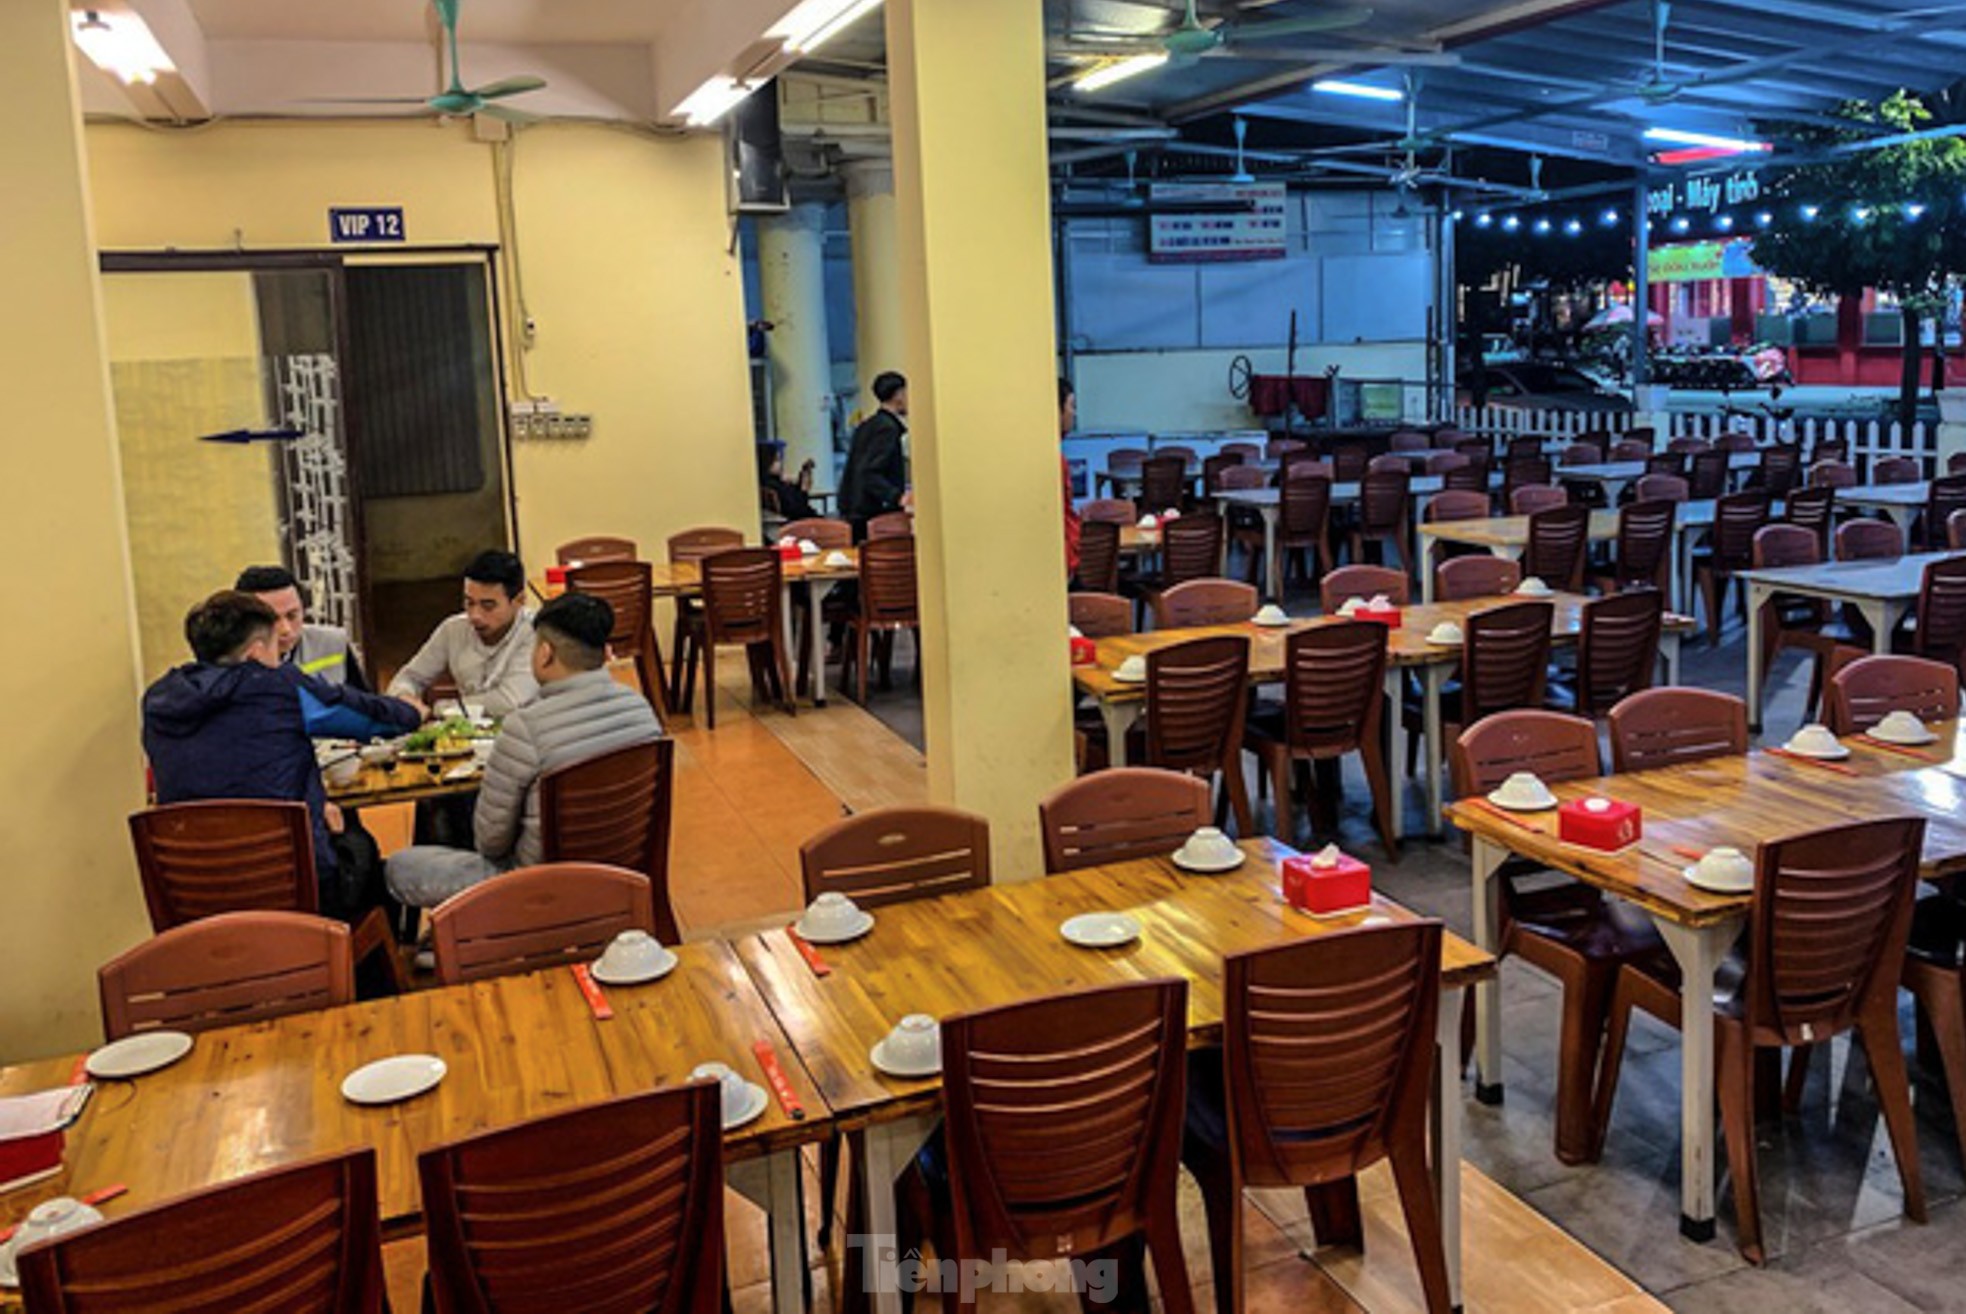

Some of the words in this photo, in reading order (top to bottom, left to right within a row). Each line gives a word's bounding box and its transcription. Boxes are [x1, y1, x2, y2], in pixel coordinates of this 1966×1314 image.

[1686, 177, 1720, 214] Máy
[339, 213, 370, 236] VIP
[376, 213, 400, 236] 12
